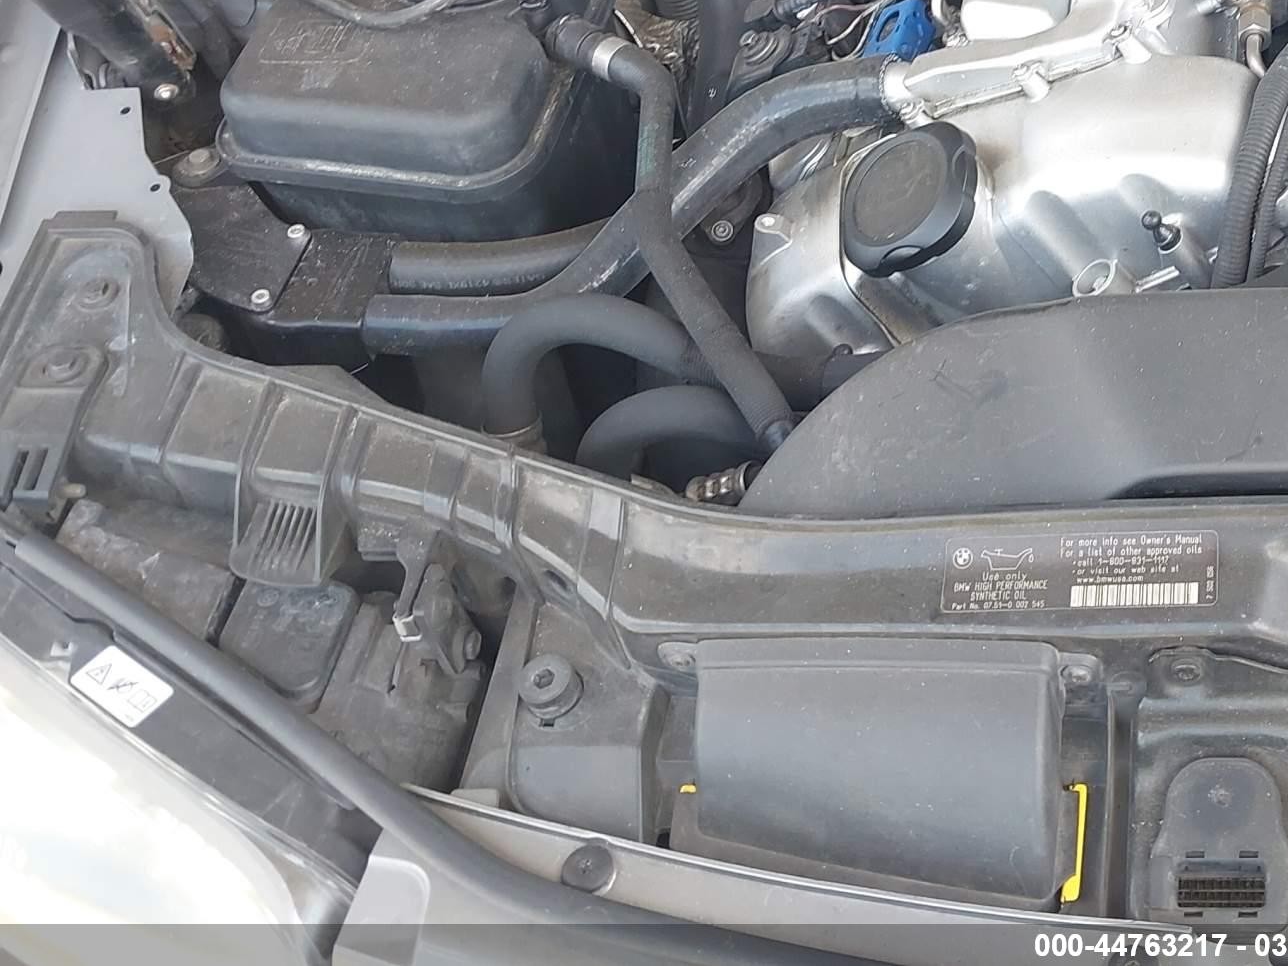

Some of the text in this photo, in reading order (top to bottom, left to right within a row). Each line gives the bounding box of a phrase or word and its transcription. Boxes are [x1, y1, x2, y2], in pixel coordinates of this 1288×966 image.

[1060, 537, 1073, 547] For
[1102, 536, 1118, 546] info
[1123, 537, 1136, 545] see
[1141, 535, 1171, 545] Owner's
[1175, 534, 1202, 544] Manual
[1060, 548, 1073, 558] For
[1087, 547, 1102, 556] list
[1107, 546, 1116, 556] of
[1120, 546, 1142, 556] other
[1146, 545, 1182, 556] approved
[1186, 544, 1202, 554] oils
[1090, 565, 1109, 574] visit
[1131, 565, 1146, 574] web
[1150, 565, 1166, 573] site
[982, 571, 1027, 581] Use only
[954, 579, 1048, 592] BMW HIGH PERFORMANCE
[970, 590, 1027, 601] SYNTHETIC OIL
